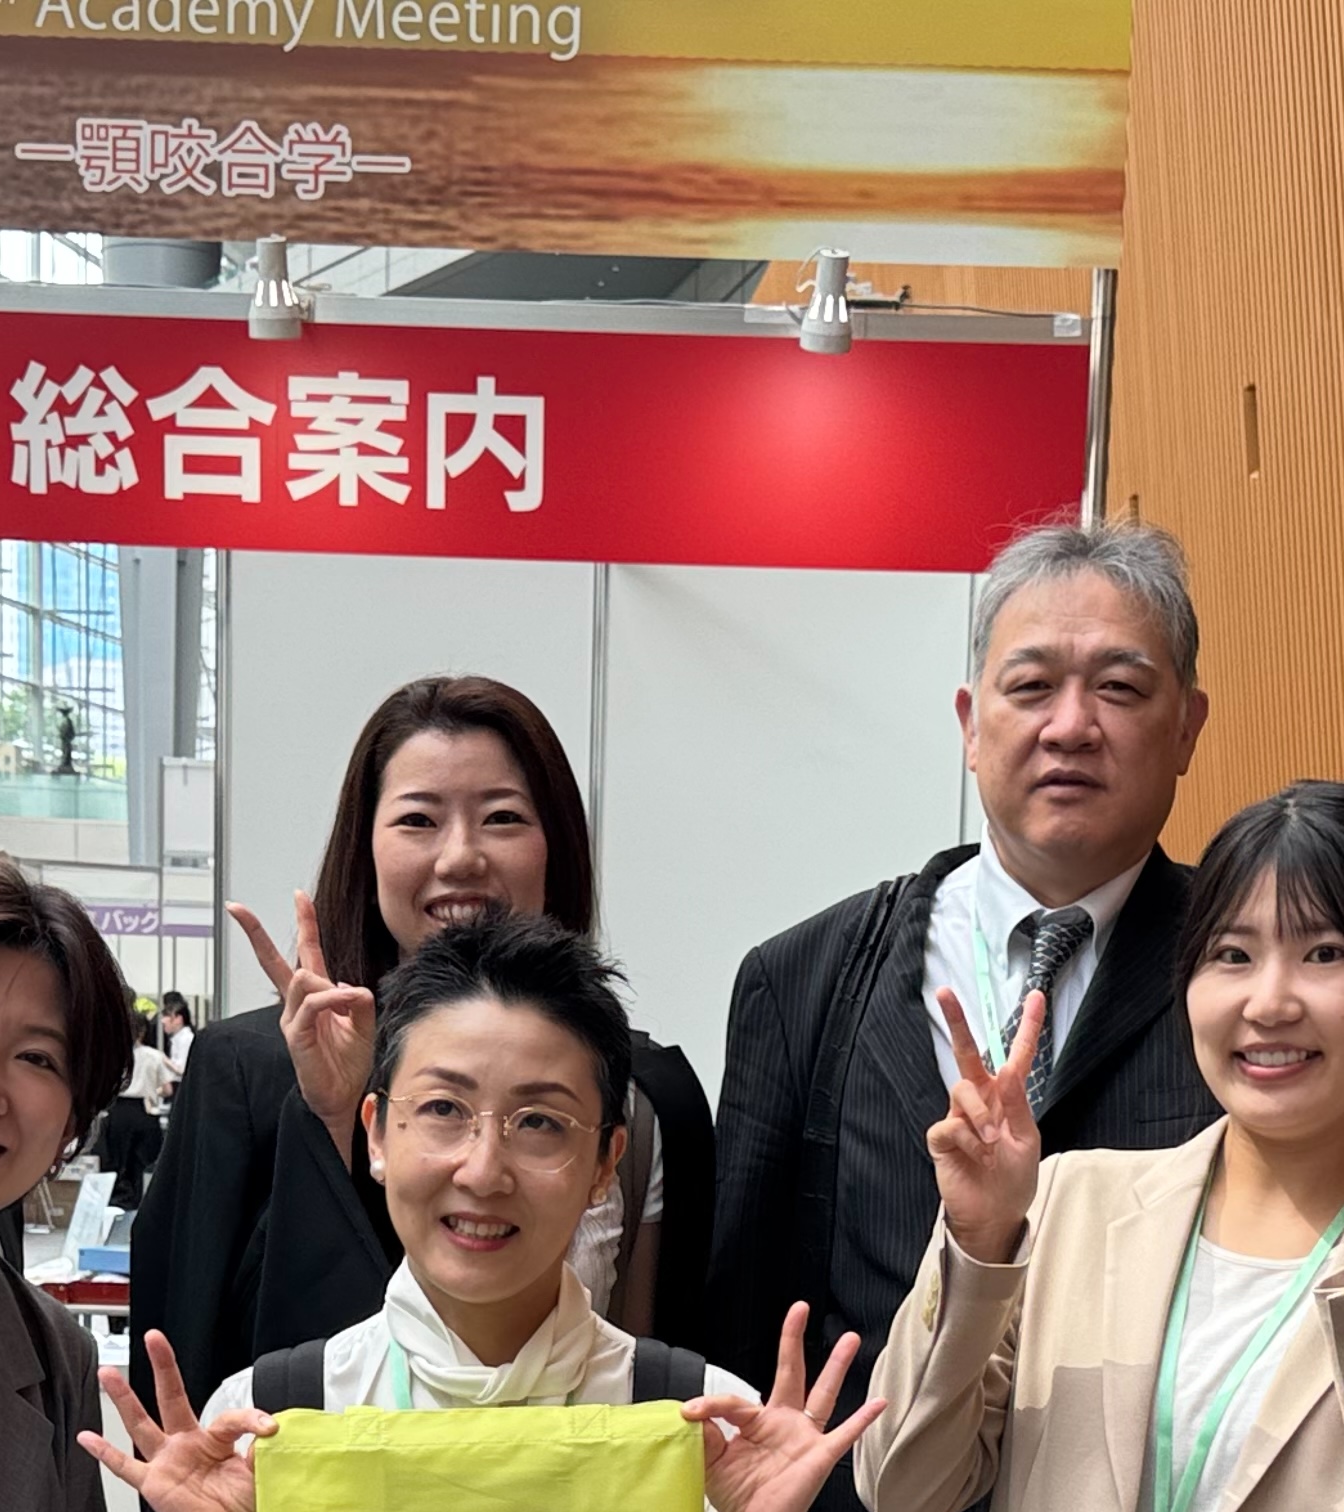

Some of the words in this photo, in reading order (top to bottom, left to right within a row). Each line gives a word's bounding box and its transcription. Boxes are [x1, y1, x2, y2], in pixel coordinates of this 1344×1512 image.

[335, 0, 581, 61] Meeting
[8, 359, 545, 512] 総合案内
